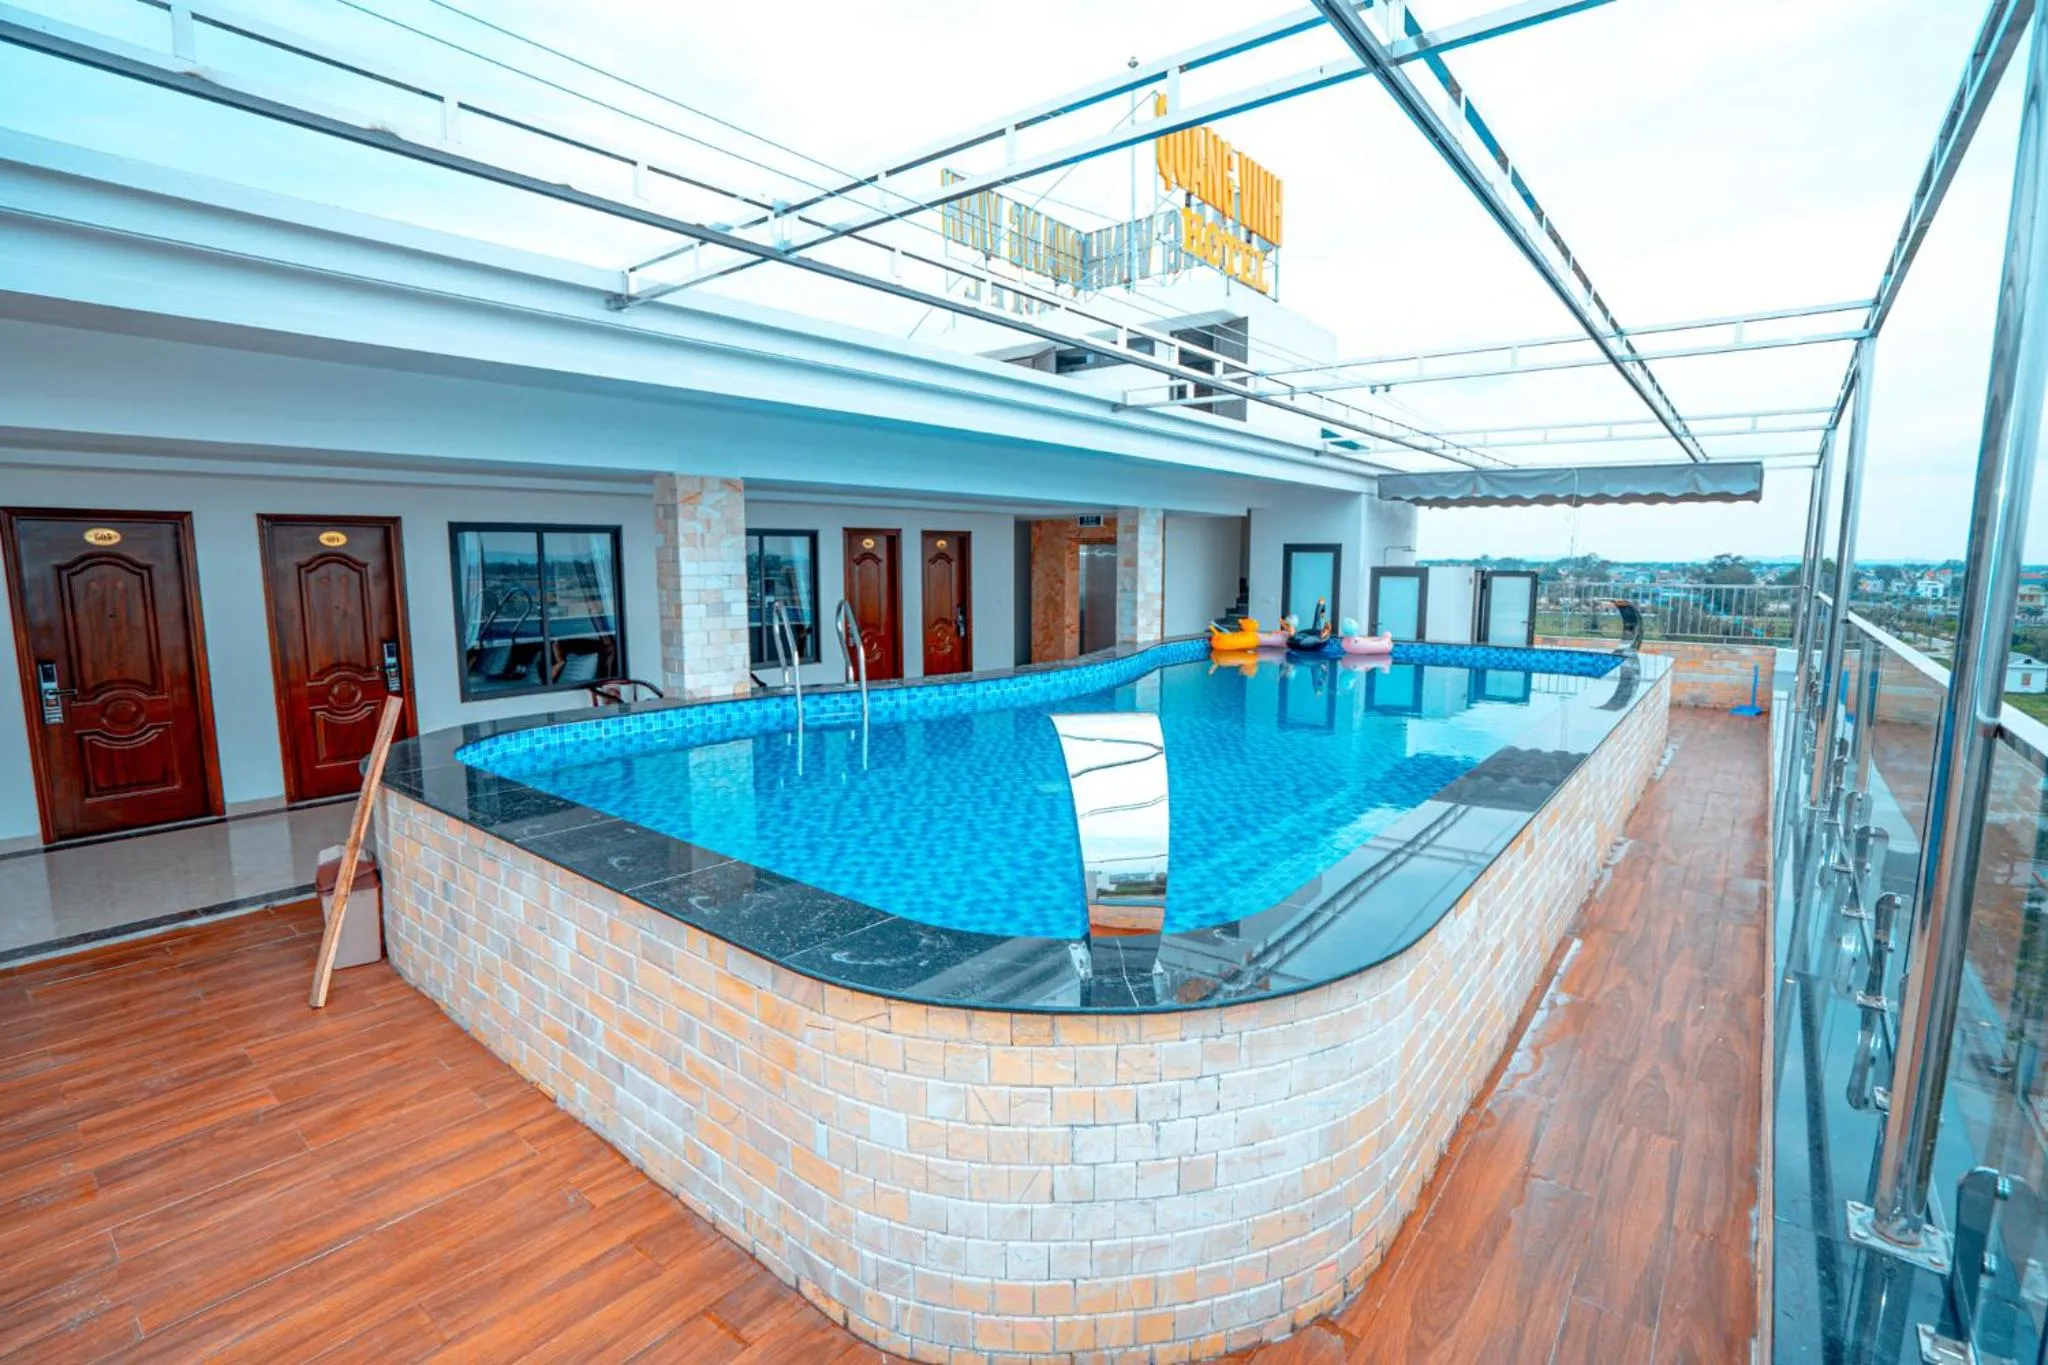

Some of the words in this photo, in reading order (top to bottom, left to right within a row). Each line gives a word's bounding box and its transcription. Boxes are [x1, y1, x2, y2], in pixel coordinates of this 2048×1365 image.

[1155, 93, 1234, 219] QUANG
[1239, 151, 1283, 247] VINH
[1181, 207, 1269, 294] HOTEL
